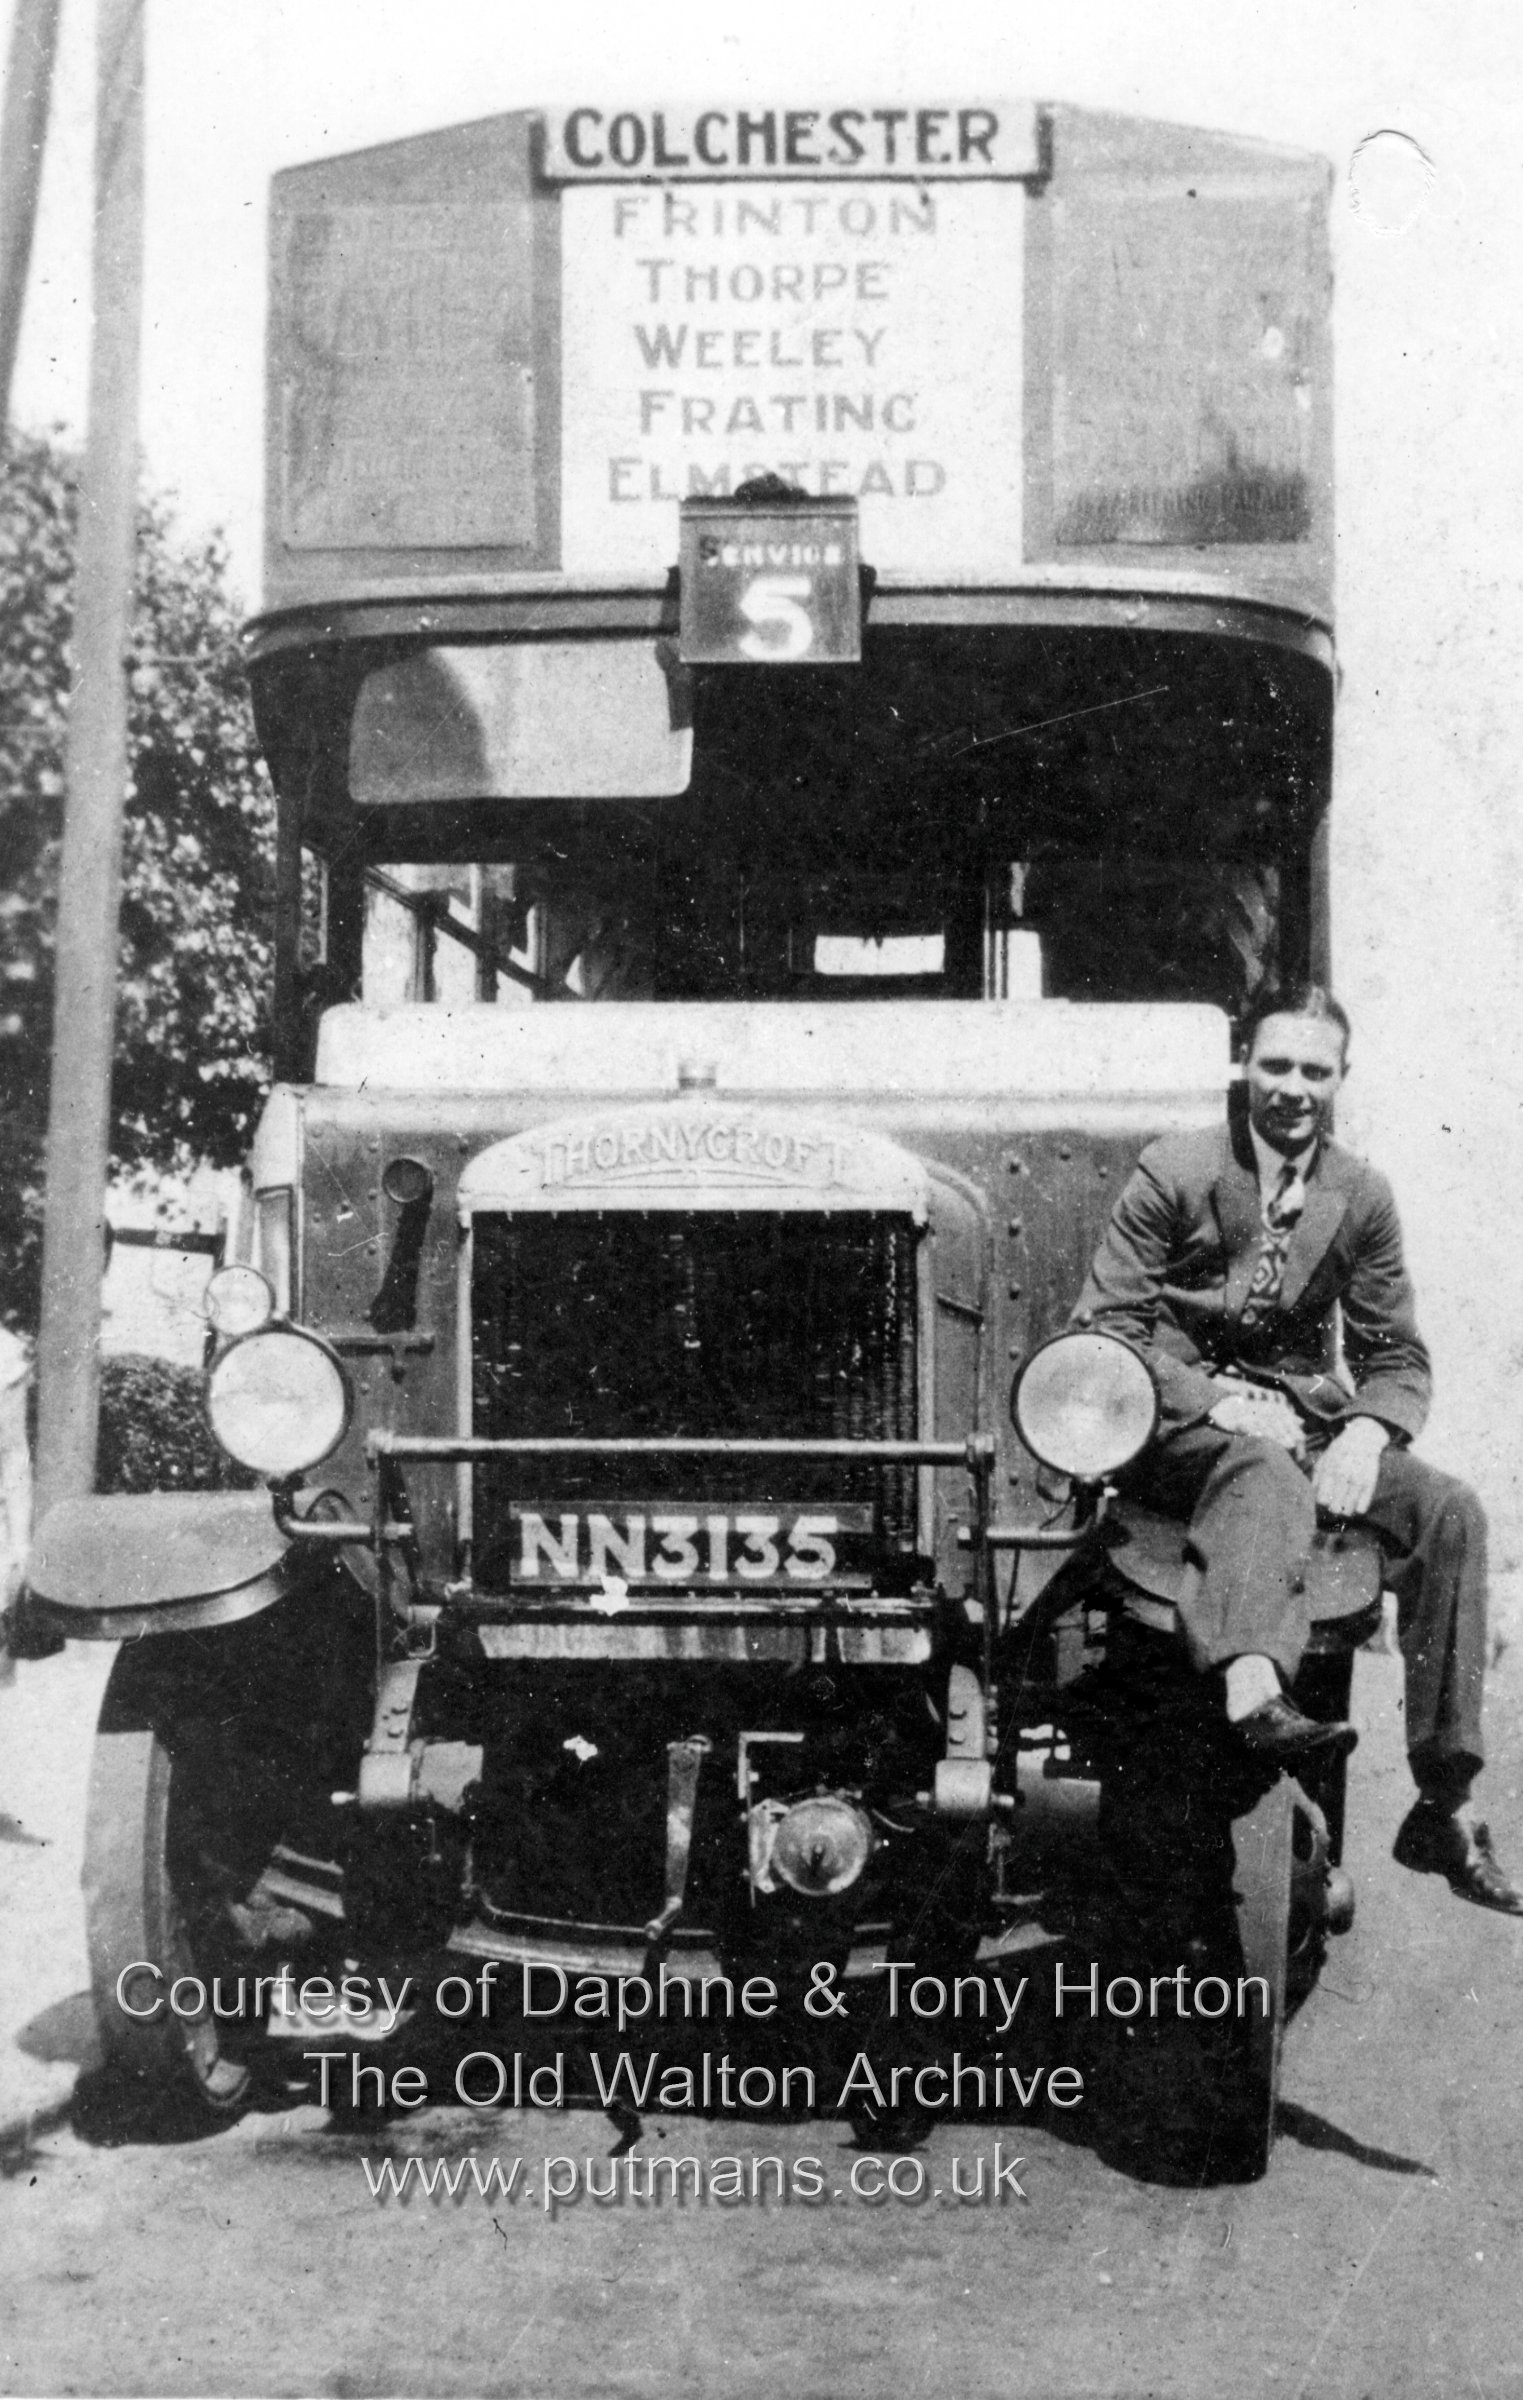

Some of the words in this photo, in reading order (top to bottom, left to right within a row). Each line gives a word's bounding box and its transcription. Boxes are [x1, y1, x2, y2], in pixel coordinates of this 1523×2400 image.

[562, 107, 1000, 169] COLCHESTER
[612, 196, 938, 237] FRINTON
[635, 257, 891, 303] THORPE
[633, 323, 888, 369] WEELEY
[739, 573, 814, 662] 5
[536, 1118, 851, 1187] THORNYCROFT
[520, 1513, 838, 1580] NN3135
